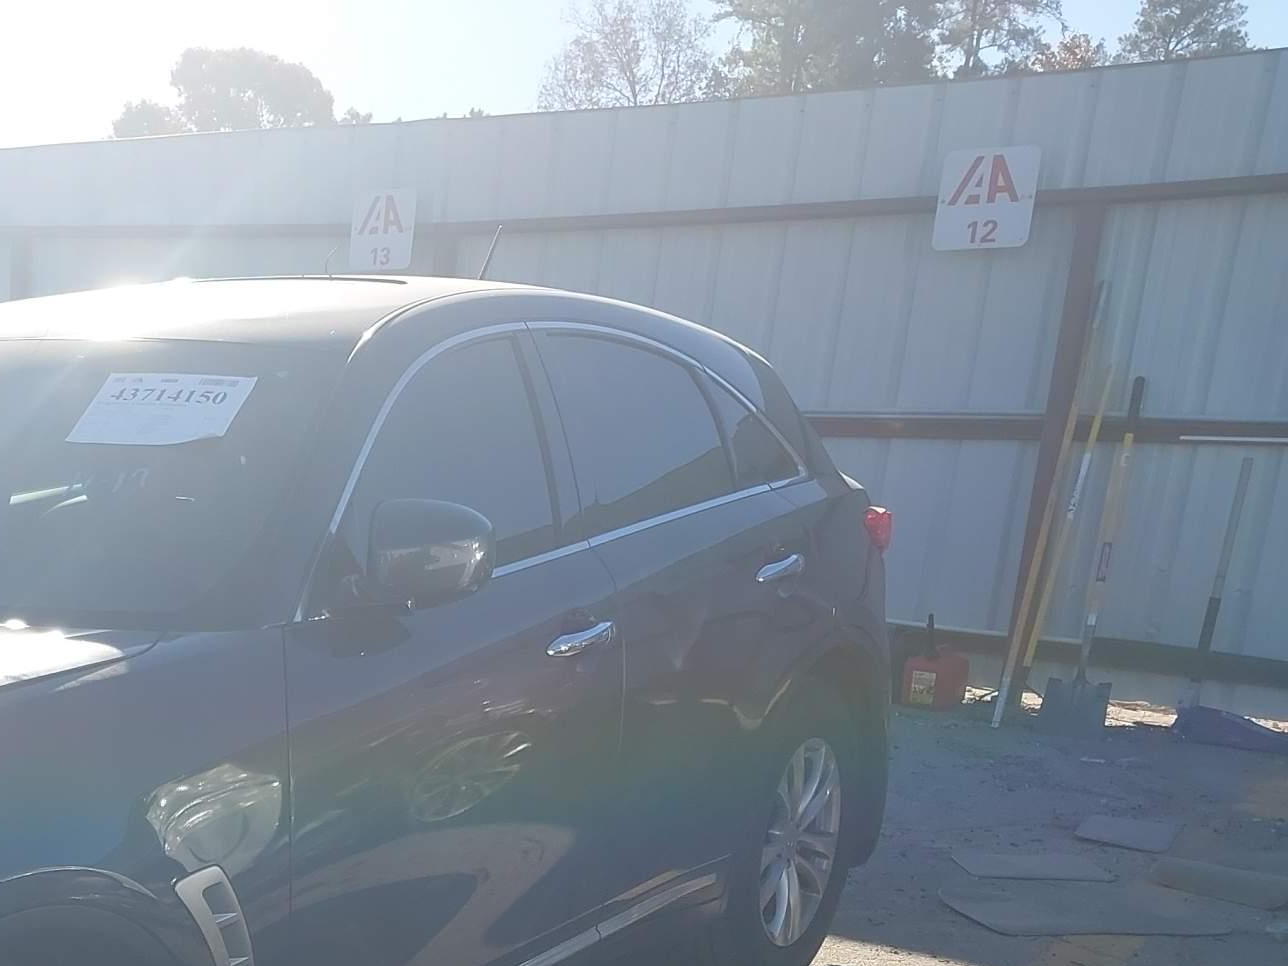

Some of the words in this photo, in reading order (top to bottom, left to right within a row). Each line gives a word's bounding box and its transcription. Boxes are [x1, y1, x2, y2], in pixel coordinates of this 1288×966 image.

[967, 219, 998, 244] 12
[369, 247, 391, 265] 13
[109, 387, 228, 405] 43714150
